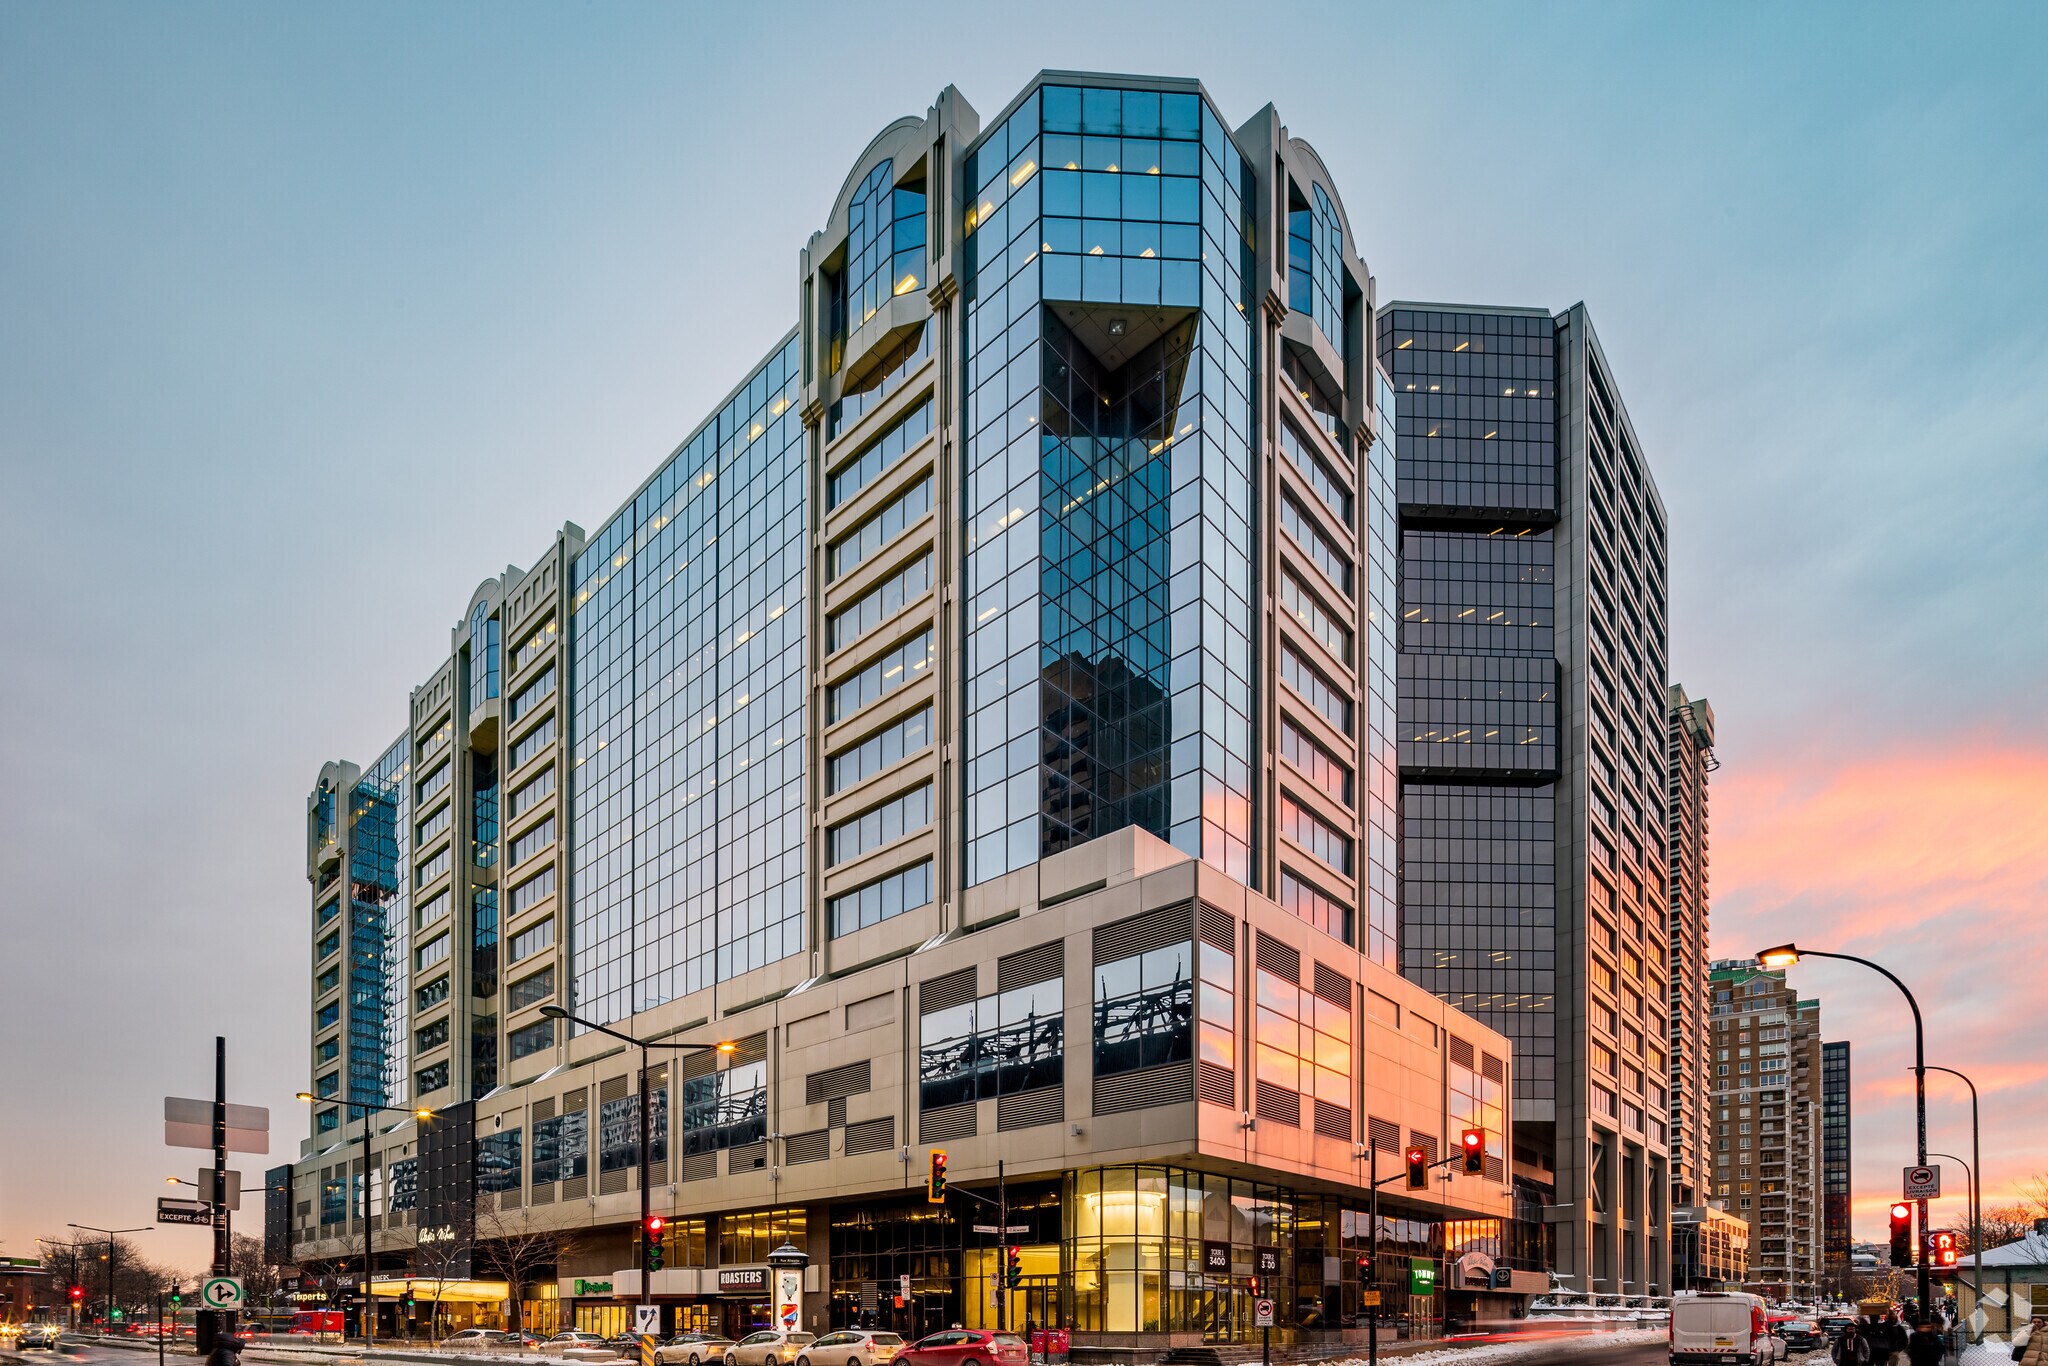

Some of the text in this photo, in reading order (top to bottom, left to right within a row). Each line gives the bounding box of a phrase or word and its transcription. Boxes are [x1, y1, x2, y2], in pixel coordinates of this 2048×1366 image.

[160, 1212, 192, 1221] EXCEPTÉ
[1209, 1257, 1226, 1266] 3400
[1261, 1261, 1276, 1269] 300
[720, 1271, 762, 1284] ROASTERS
